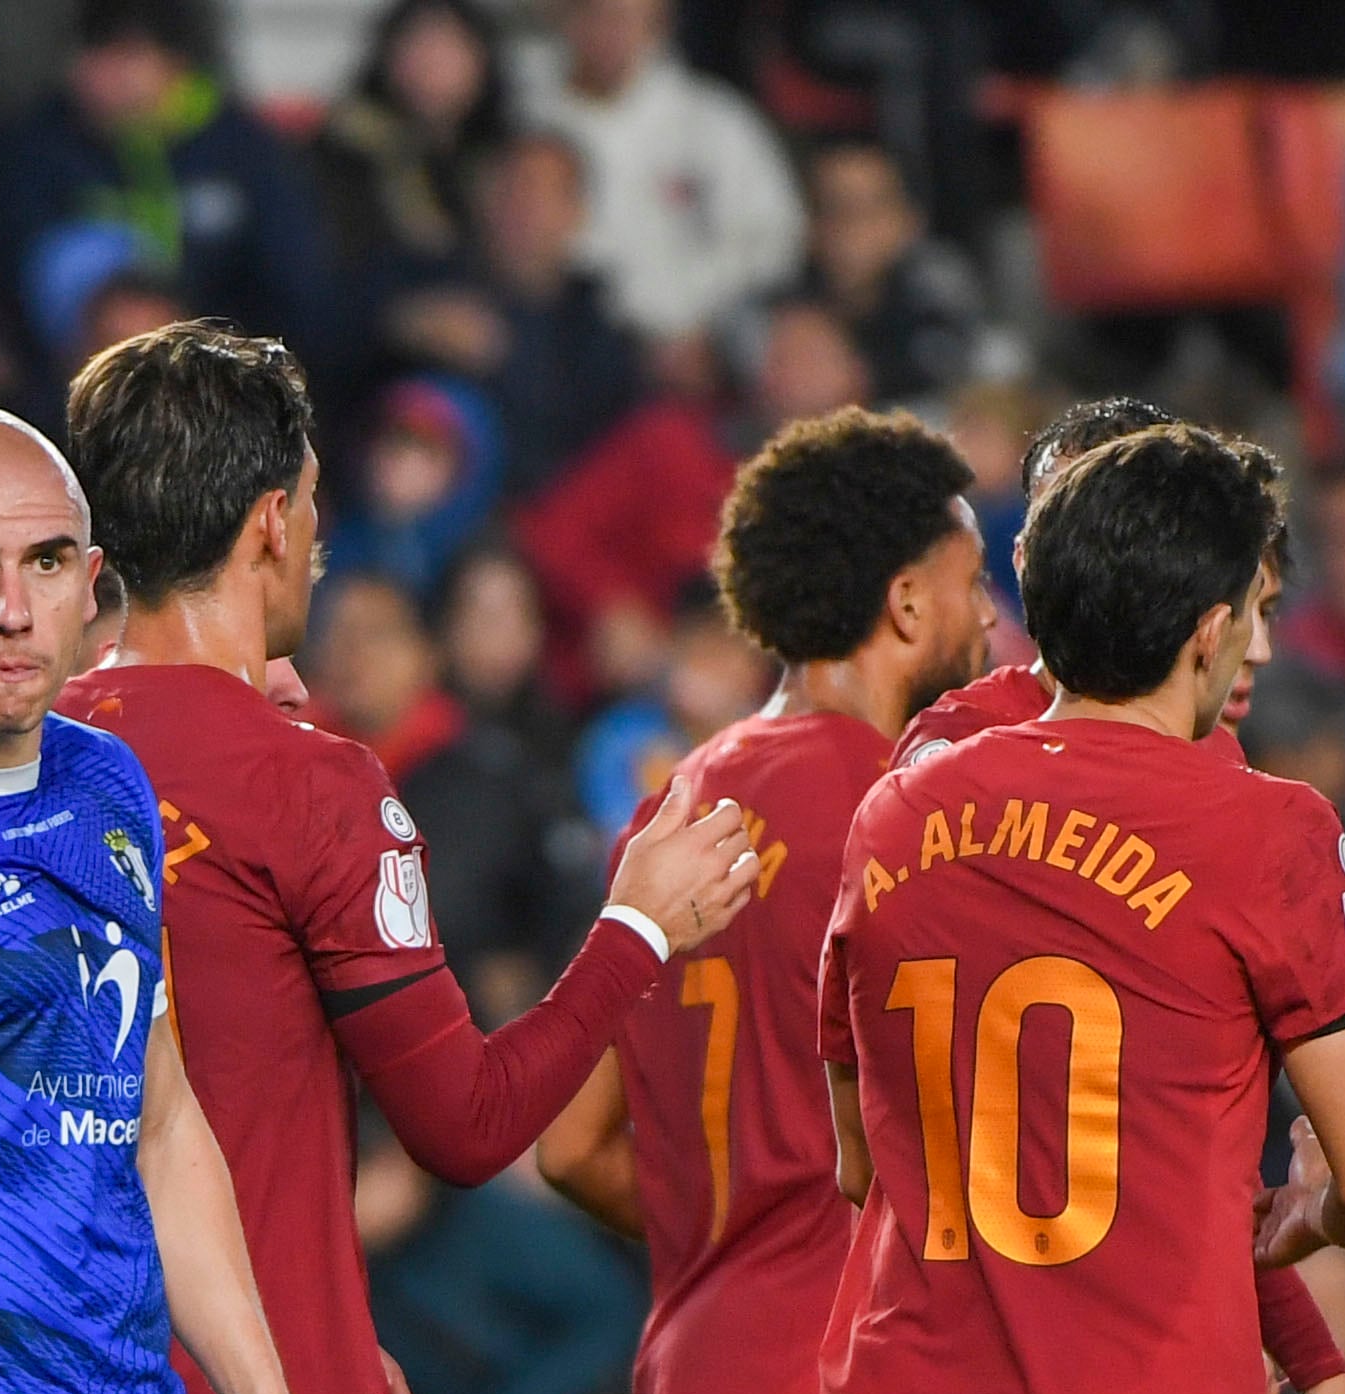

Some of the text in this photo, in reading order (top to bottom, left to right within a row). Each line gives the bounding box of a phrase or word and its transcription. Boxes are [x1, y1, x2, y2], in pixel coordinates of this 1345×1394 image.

[860, 799, 1193, 931] A. ALMEIDA
[21, 1110, 140, 1147] de Mace
[885, 955, 1124, 1267] 10
